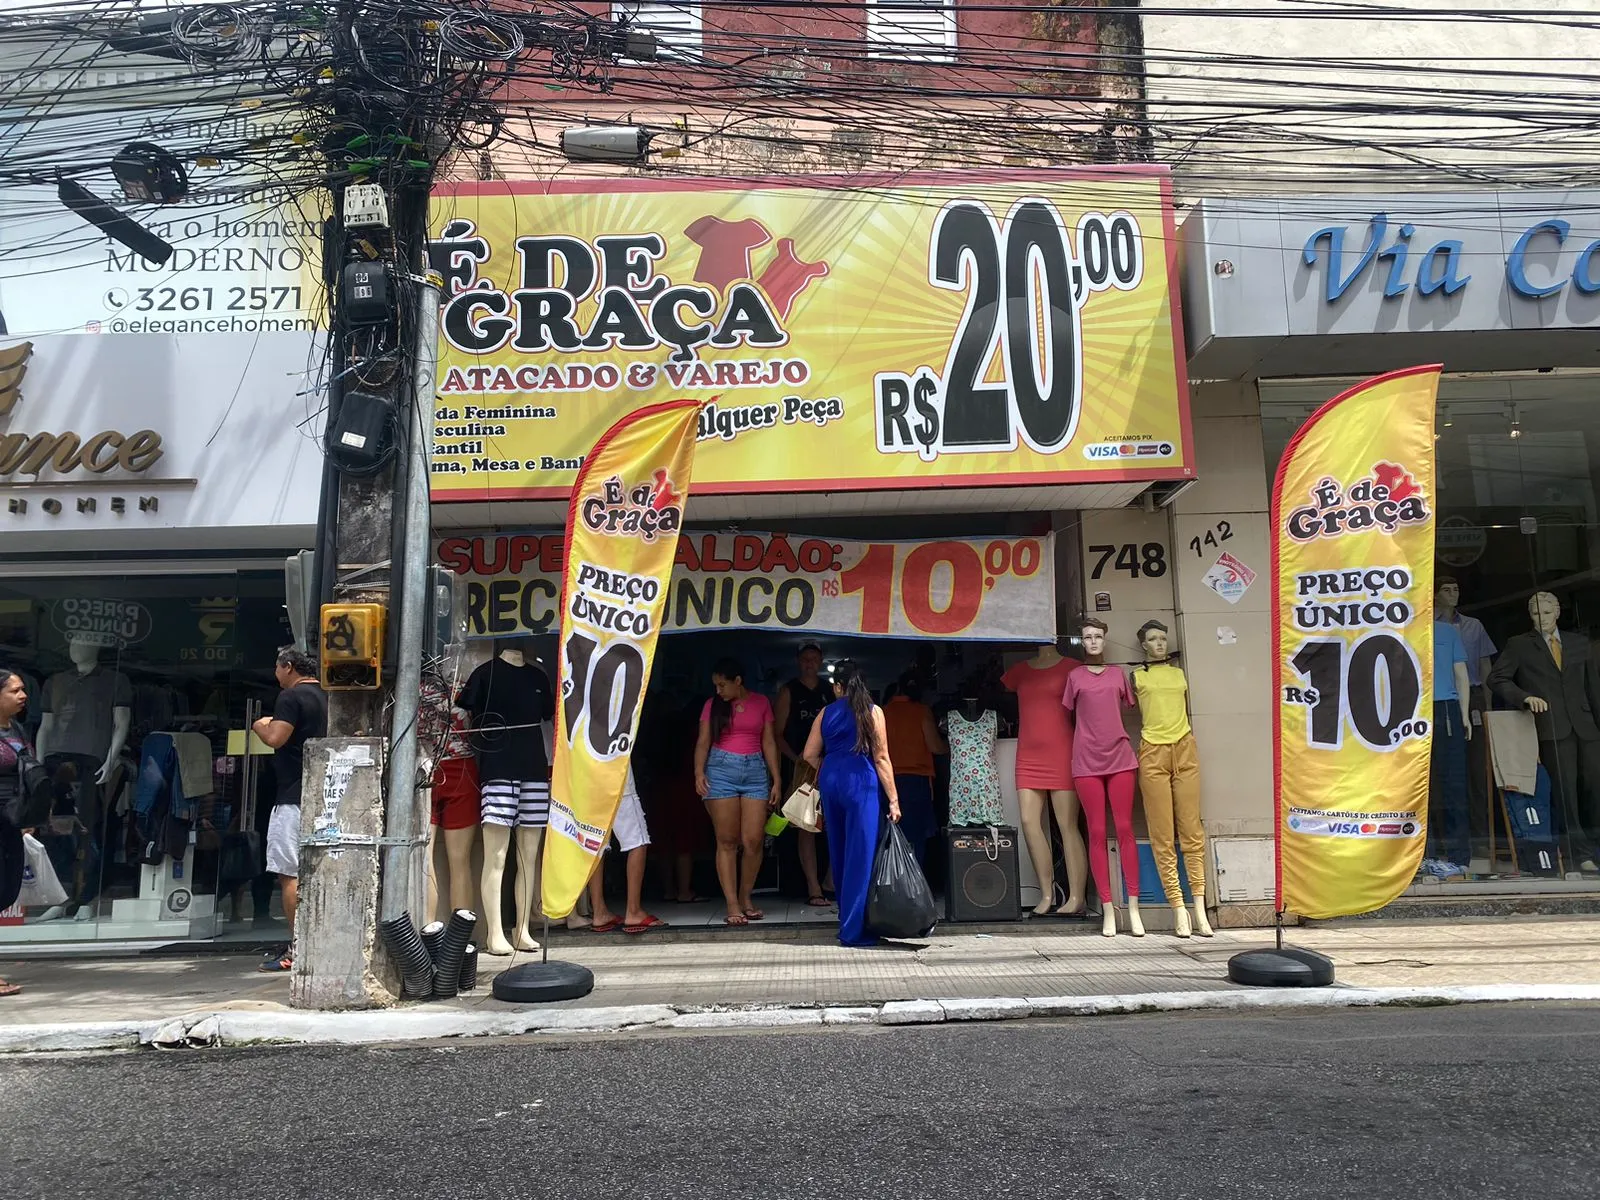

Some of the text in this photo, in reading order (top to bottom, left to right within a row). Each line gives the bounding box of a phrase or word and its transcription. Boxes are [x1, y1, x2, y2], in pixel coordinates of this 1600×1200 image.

[184, 221, 202, 238] o
[212, 215, 324, 238] homem
[517, 236, 669, 303] DE
[1303, 212, 1472, 301] Via
[135, 286, 302, 311] 3261 2571
[444, 287, 788, 361] GRAÇA
[442, 360, 809, 392] ATACADO & VAREJO
[436, 405, 556, 420] da Feminina
[696, 398, 841, 438] alquer Peça
[435, 423, 505, 436] sculina
[432, 441, 482, 454] antil
[1088, 447, 1118, 456] VISA
[431, 456, 583, 474] ma, Mesa e Ban
[605, 476, 624, 505] É
[1315, 480, 1389, 509] É de
[583, 498, 680, 539] Graça
[1289, 497, 1426, 539] Graça
[438, 532, 843, 575] SUPE ALDÃO:
[1190, 520, 1233, 557] 742
[1089, 543, 1167, 580] 748
[467, 539, 1041, 634] REÇ NICO R$ 10,00
[578, 564, 658, 605] PREÇO
[1298, 569, 1409, 596] PREÇO
[572, 591, 649, 635] ÚNICO
[1296, 601, 1409, 628] ÚNICO
[1328, 823, 1360, 834] VISA
